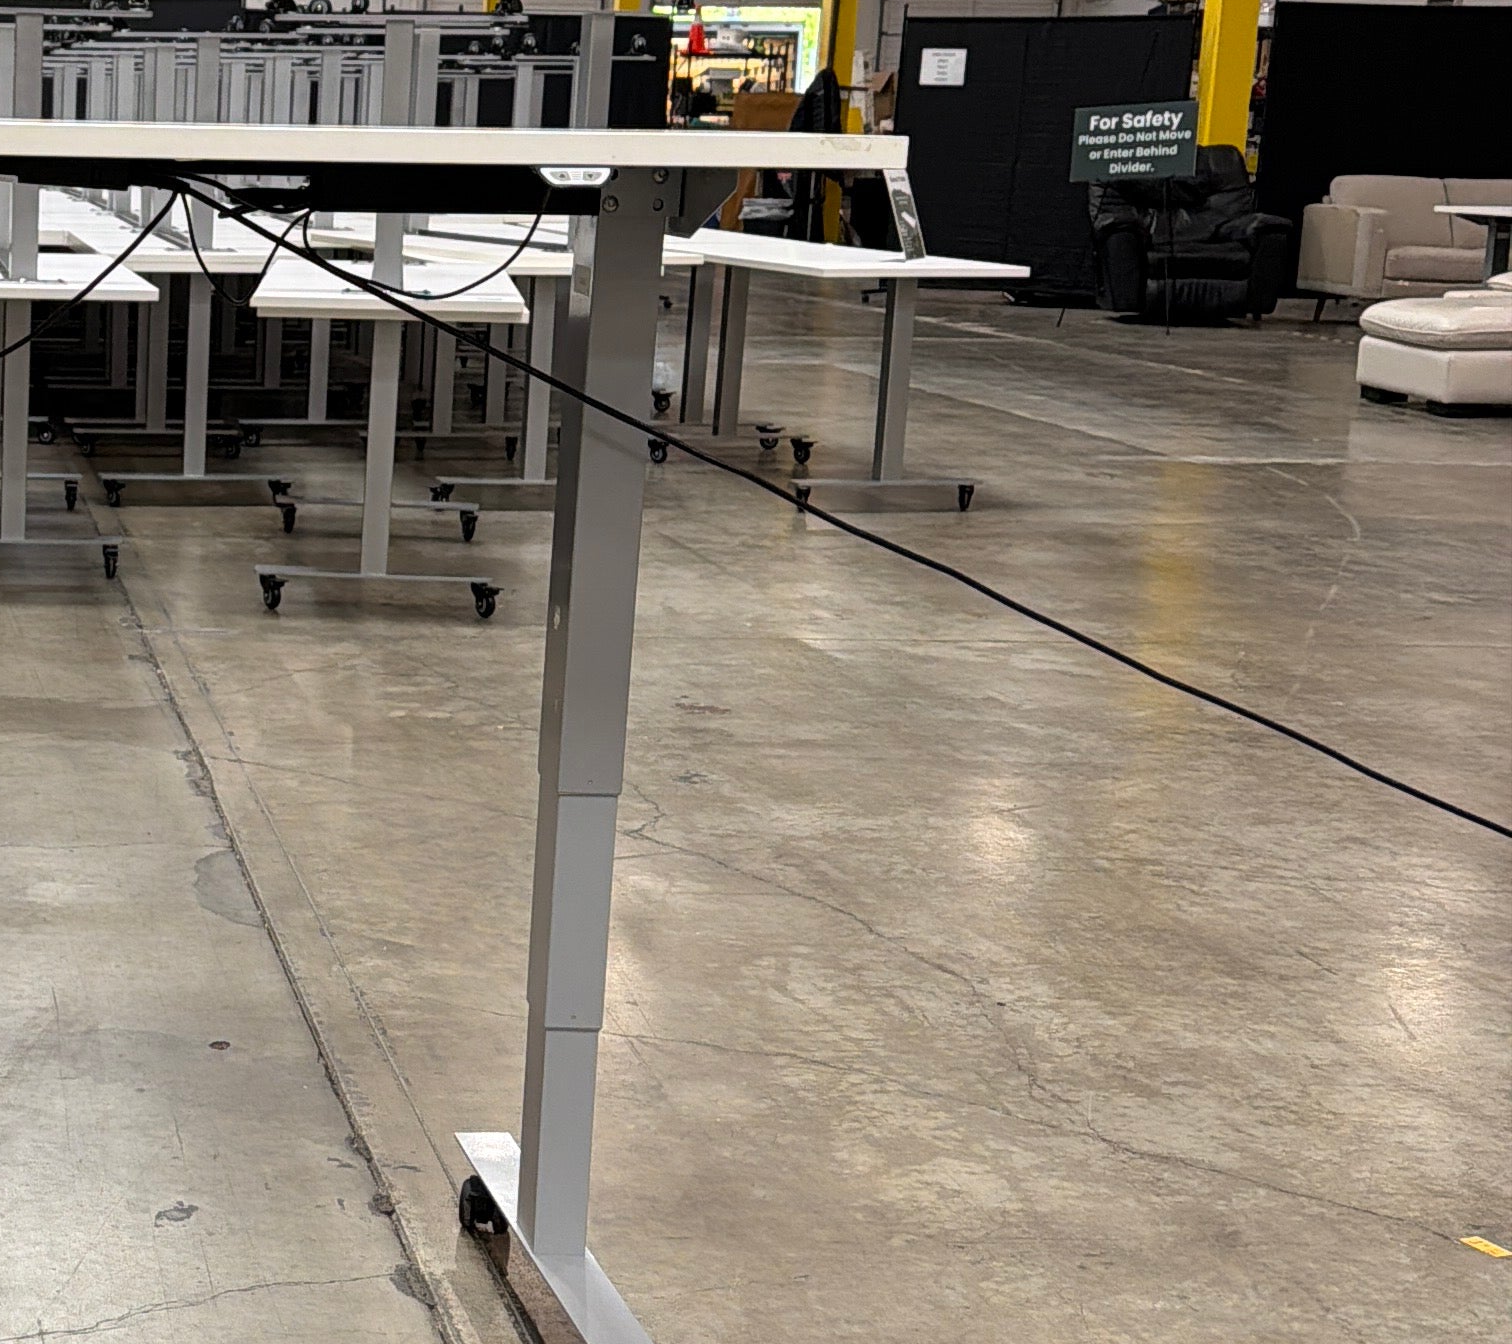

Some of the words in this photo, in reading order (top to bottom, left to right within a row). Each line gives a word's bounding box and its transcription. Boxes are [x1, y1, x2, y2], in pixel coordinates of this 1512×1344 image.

[1089, 115, 1119, 131] For
[1122, 110, 1183, 130] Safety
[1078, 134, 1116, 146] Please
[1118, 133, 1134, 143] Do
[1137, 131, 1157, 142] Not
[1159, 130, 1192, 141] Move
[1089, 150, 1102, 160] or
[1103, 148, 1134, 159] Enter
[1135, 144, 1178, 156] Behind
[1108, 161, 1155, 174] Divider.
